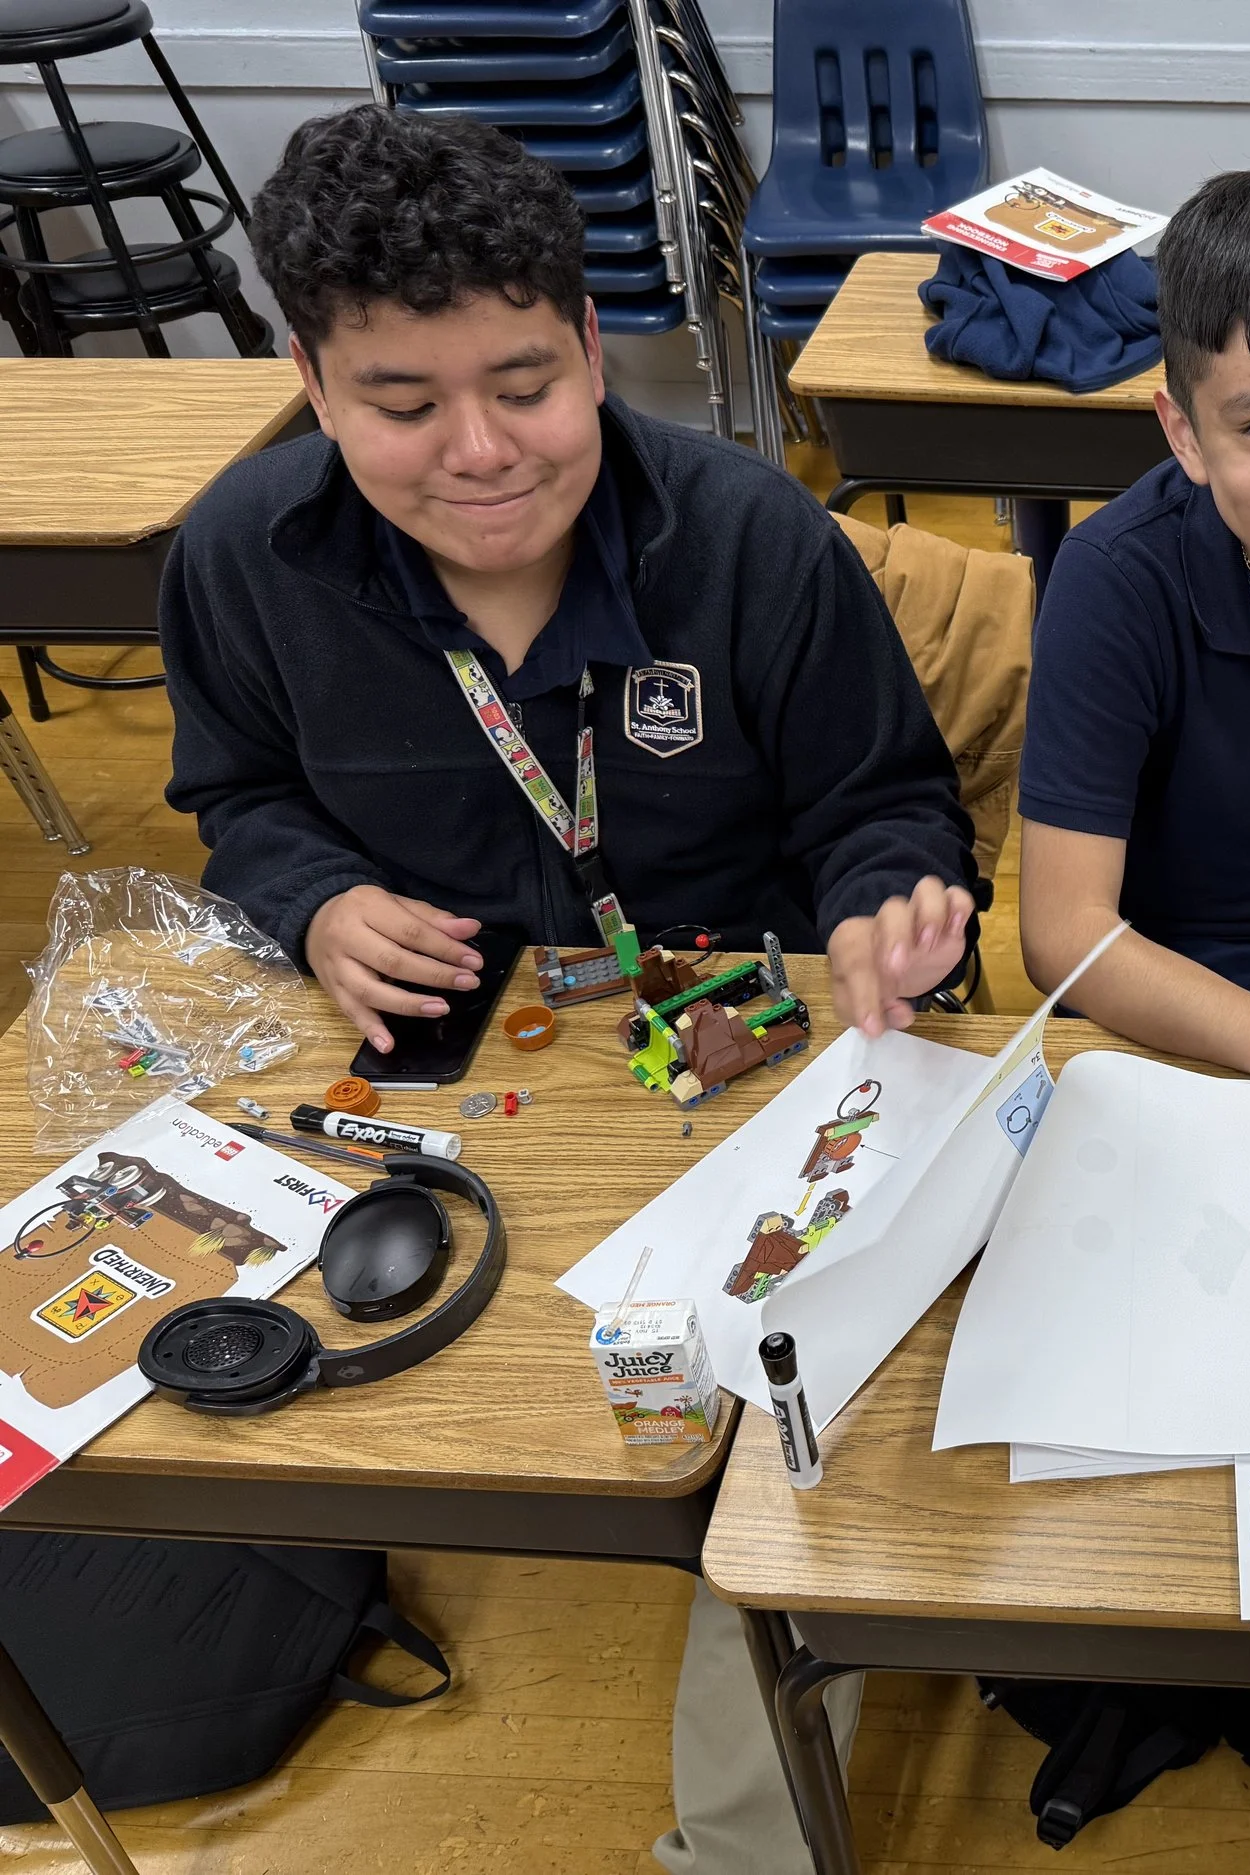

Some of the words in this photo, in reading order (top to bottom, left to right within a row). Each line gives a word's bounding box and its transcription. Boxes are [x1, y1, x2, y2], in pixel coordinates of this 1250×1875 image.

[630, 722, 641, 730] St.
[642, 724, 671, 734] Anthony
[671, 726, 697, 735] School
[172, 1117, 223, 1148] education
[340, 1122, 387, 1144] EXPO
[273, 1174, 312, 1198] FIRST
[93, 1248, 172, 1296] UNEARTHED
[604, 1351, 674, 1367] Juicy
[612, 1364, 673, 1378] Juice
[633, 1419, 686, 1427] ORANGE
[637, 1426, 685, 1434] MEDLEY
